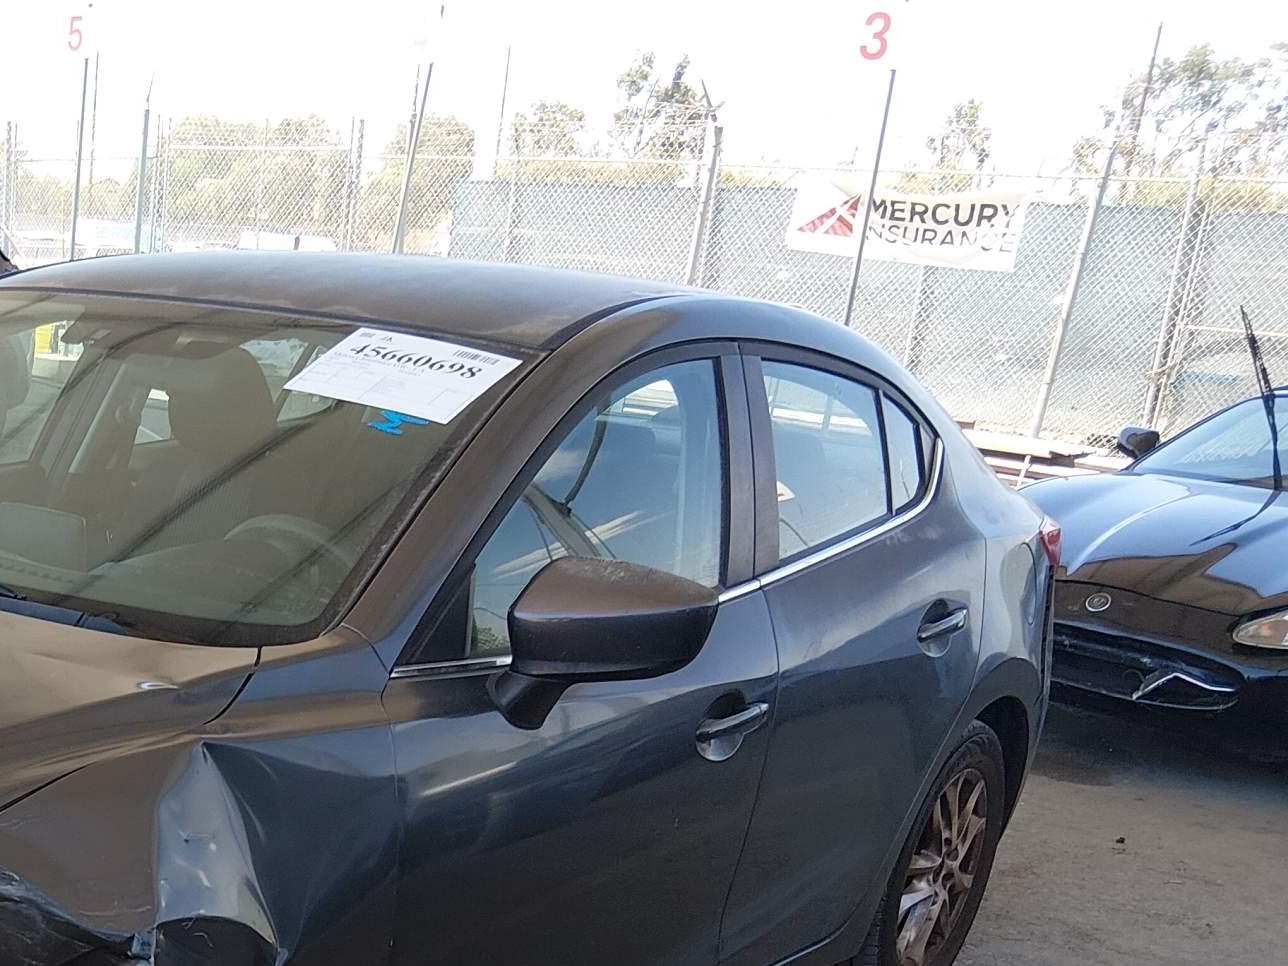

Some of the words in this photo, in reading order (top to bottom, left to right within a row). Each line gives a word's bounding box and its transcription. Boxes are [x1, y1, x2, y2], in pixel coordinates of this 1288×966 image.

[68, 16, 83, 51] 5
[859, 11, 891, 60] 3
[870, 197, 1019, 229] MERCURY
[350, 343, 483, 379] 45660698
